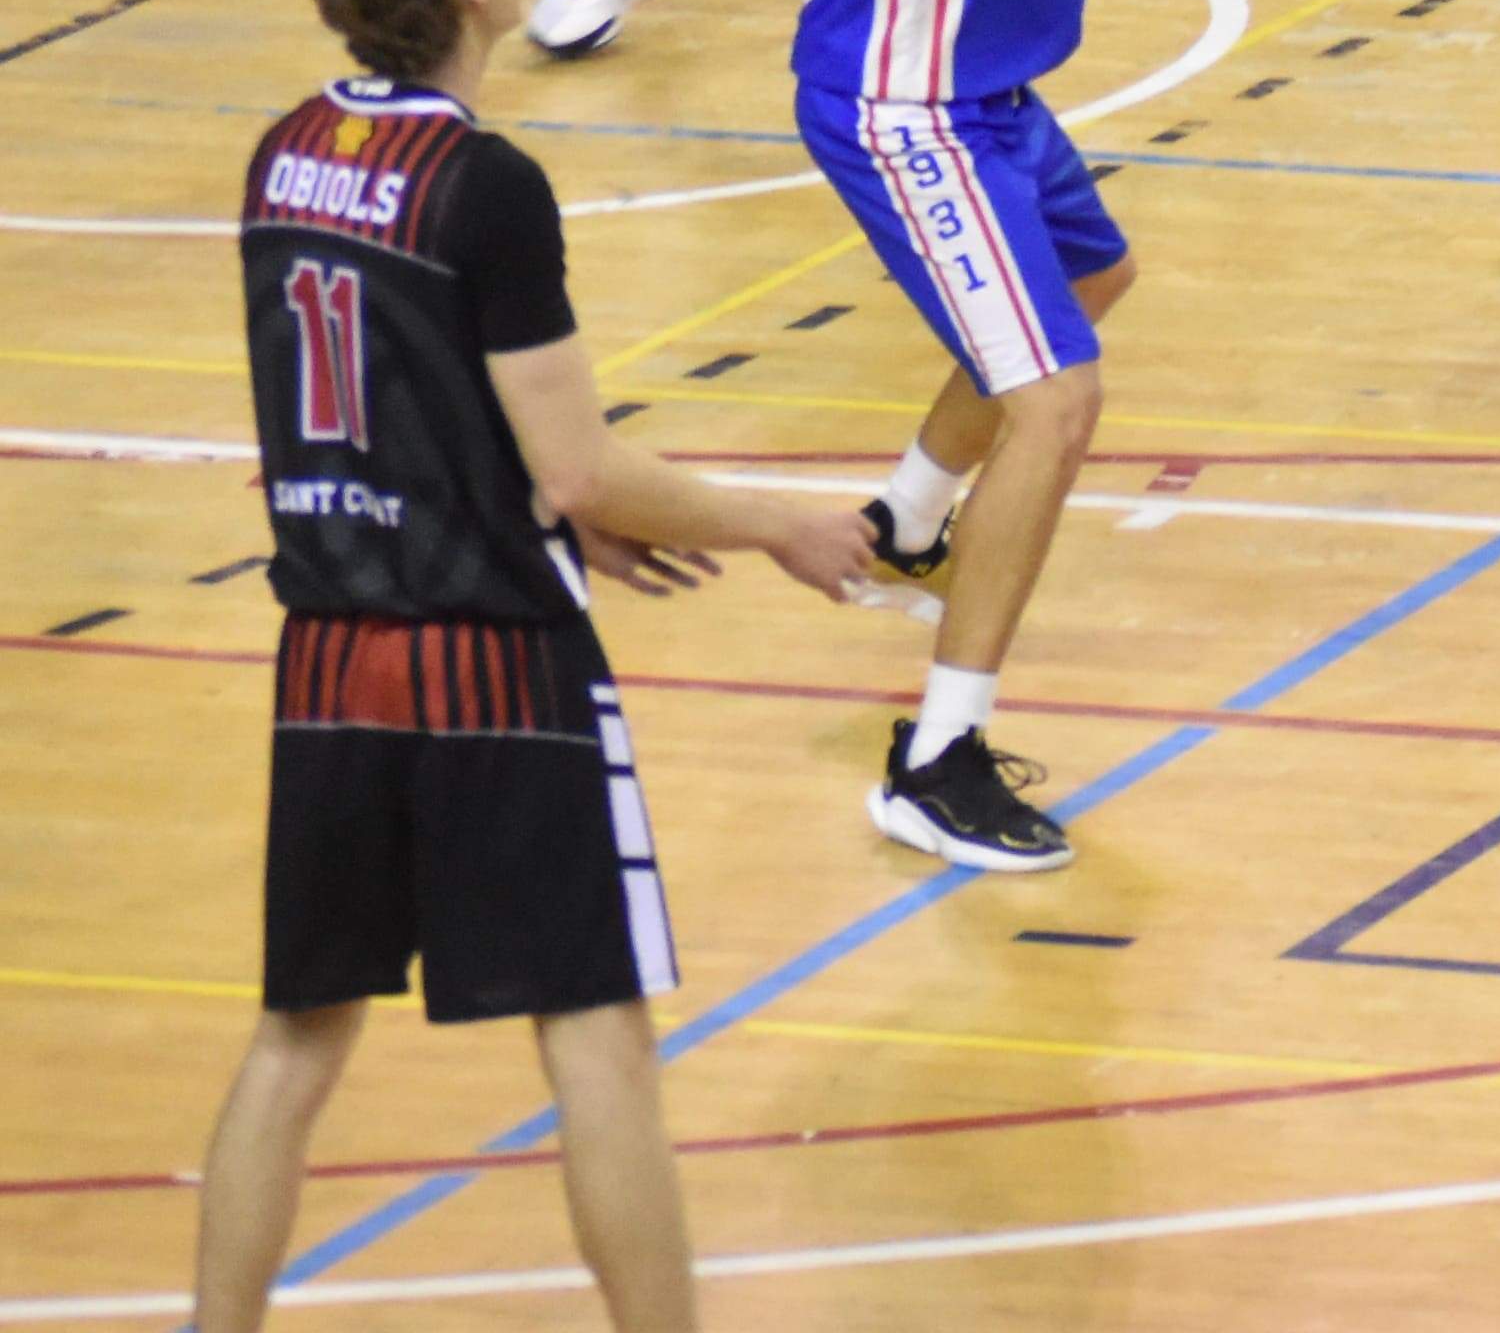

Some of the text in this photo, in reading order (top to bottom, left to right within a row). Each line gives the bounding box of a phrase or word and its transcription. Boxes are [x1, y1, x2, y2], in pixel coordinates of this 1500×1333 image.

[264, 152, 407, 226] OBIOLS
[892, 125, 988, 293] 1931
[283, 256, 371, 453] 11
